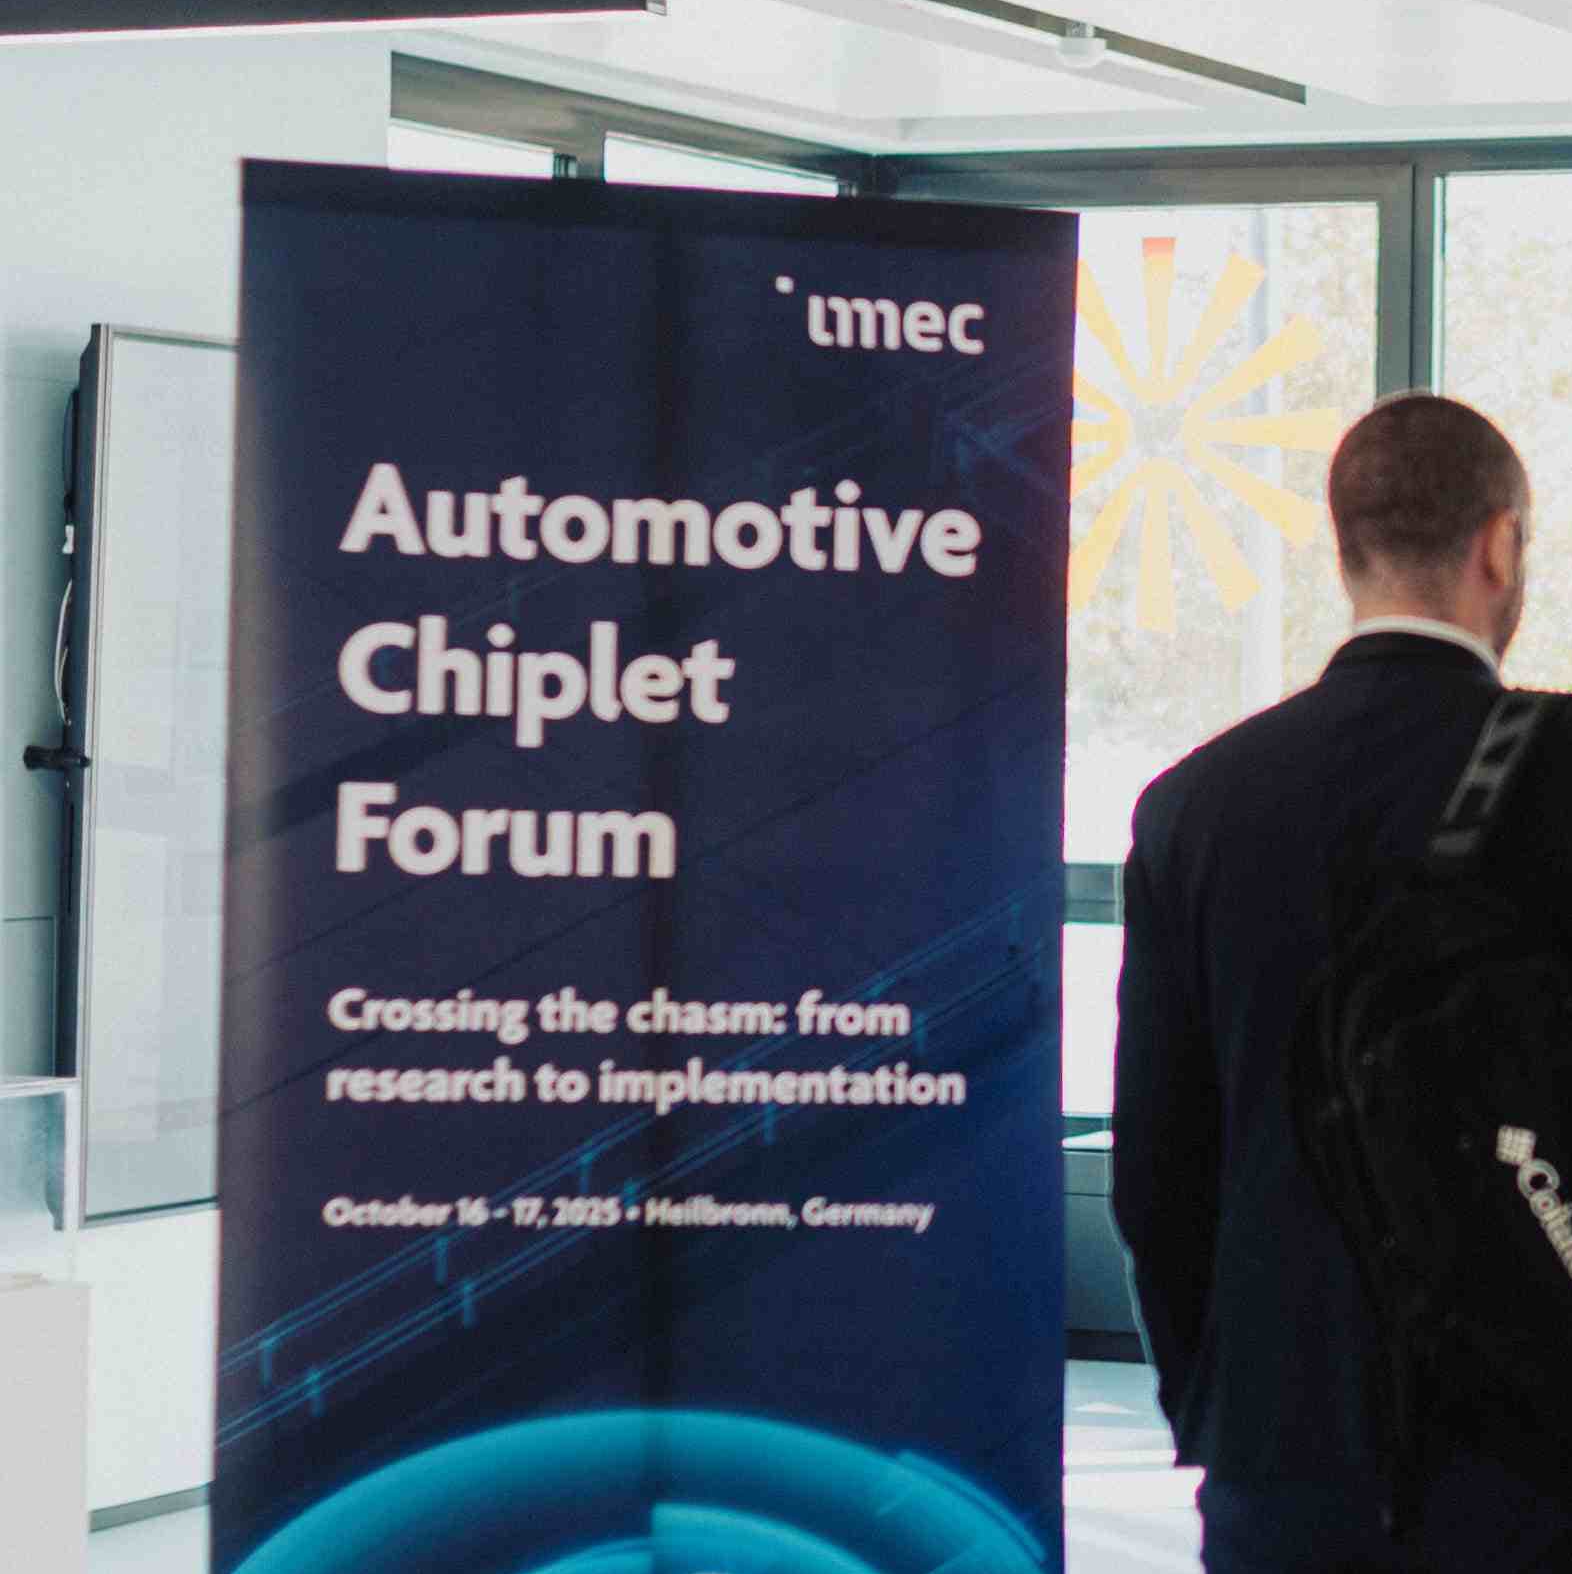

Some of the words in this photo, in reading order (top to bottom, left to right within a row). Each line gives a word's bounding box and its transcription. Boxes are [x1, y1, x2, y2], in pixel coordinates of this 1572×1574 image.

[776, 276, 984, 354] imec
[339, 463, 981, 576] Automotive
[339, 615, 735, 748] Chiplet
[336, 782, 675, 878] Forum
[328, 988, 529, 1044] Crossing
[536, 987, 618, 1033] the
[627, 988, 787, 1034] chasm:
[796, 990, 910, 1035] from
[327, 1056, 525, 1102] research
[534, 1064, 590, 1102] to
[599, 1057, 965, 1115] implementation
[323, 1196, 453, 1226] October
[456, 1198, 490, 1226] 16
[512, 1197, 547, 1228] 17,
[552, 1197, 621, 1226] 2025
[646, 1196, 797, 1227] Heilbronn,
[802, 1197, 934, 1233] Germany
